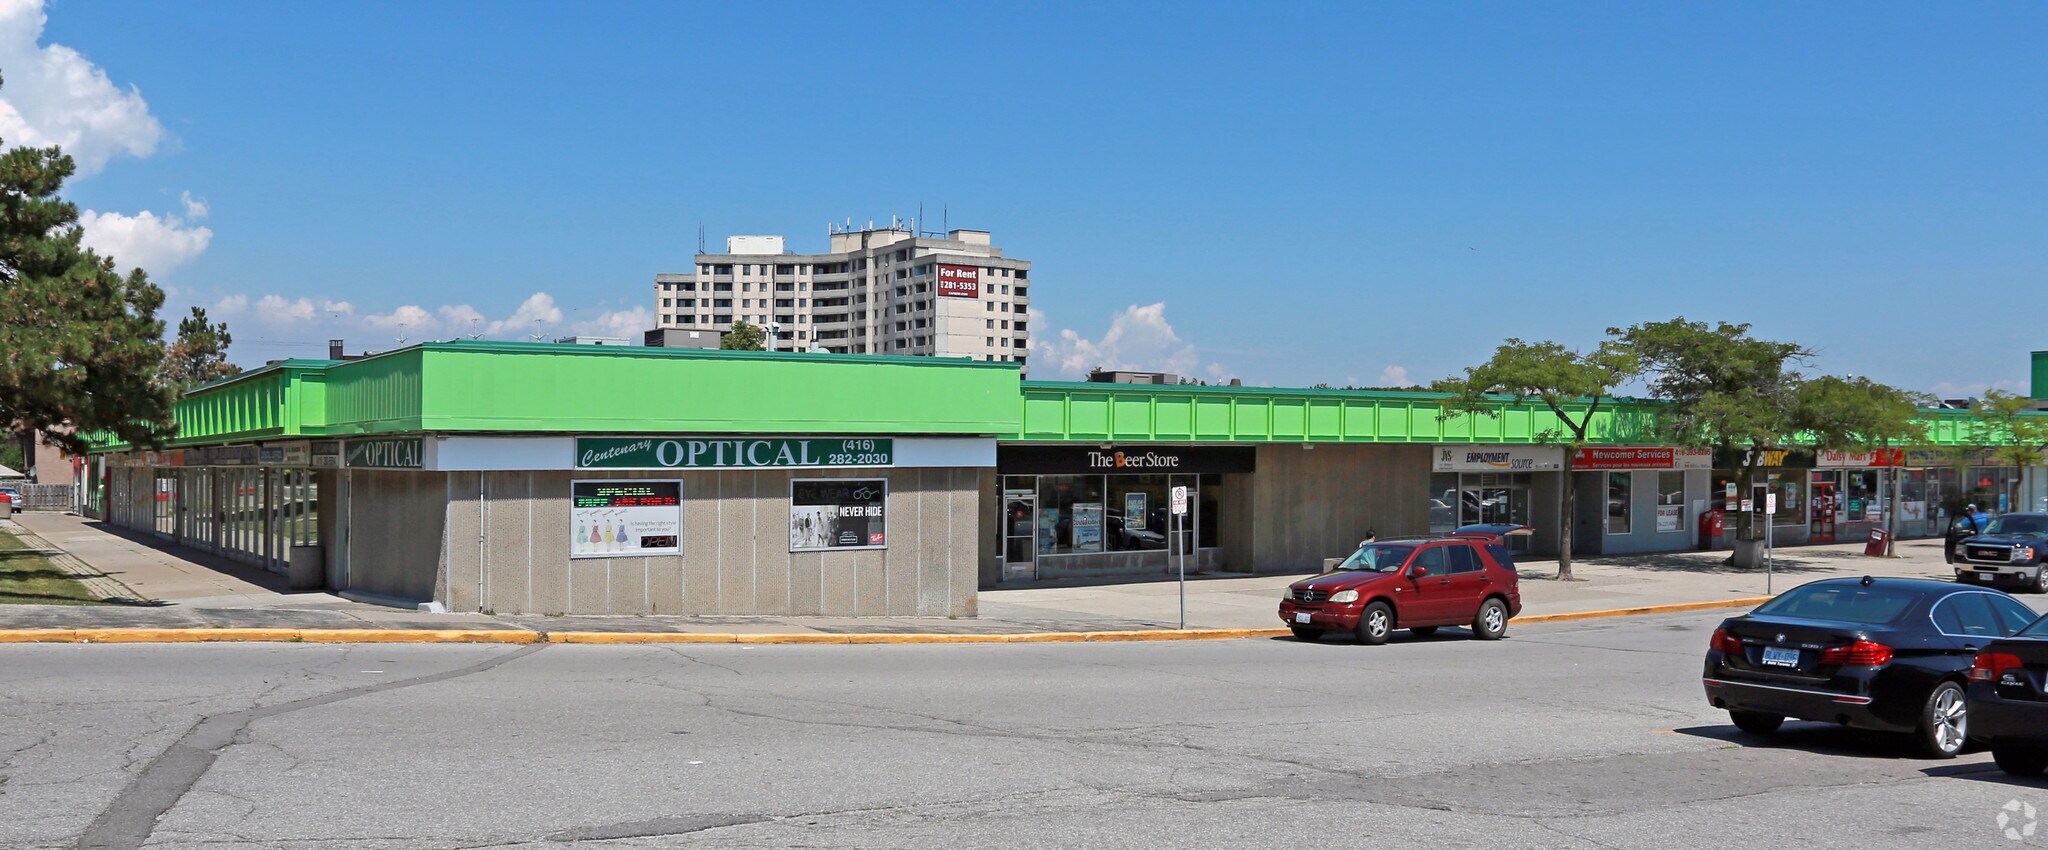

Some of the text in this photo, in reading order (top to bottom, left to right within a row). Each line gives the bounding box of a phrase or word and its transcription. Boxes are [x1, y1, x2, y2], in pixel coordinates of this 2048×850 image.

[940, 268, 977, 279] For Rent
[944, 281, 976, 291] 281-5353
[842, 440, 875, 453] (416)
[365, 440, 422, 467] OPTICAL
[581, 439, 820, 467] Centenary OPTICAL
[828, 453, 888, 465] 282-2030
[1466, 452, 1510, 463] EMPLOYMENT
[1592, 449, 1671, 459] Newcomer Services
[1742, 450, 1788, 467] SBWAY
[1826, 450, 1846, 466] Daisy
[1087, 451, 1179, 468] The Beer Store
[839, 506, 883, 517] NEVER HIDE
[641, 536, 677, 548] OPEN
